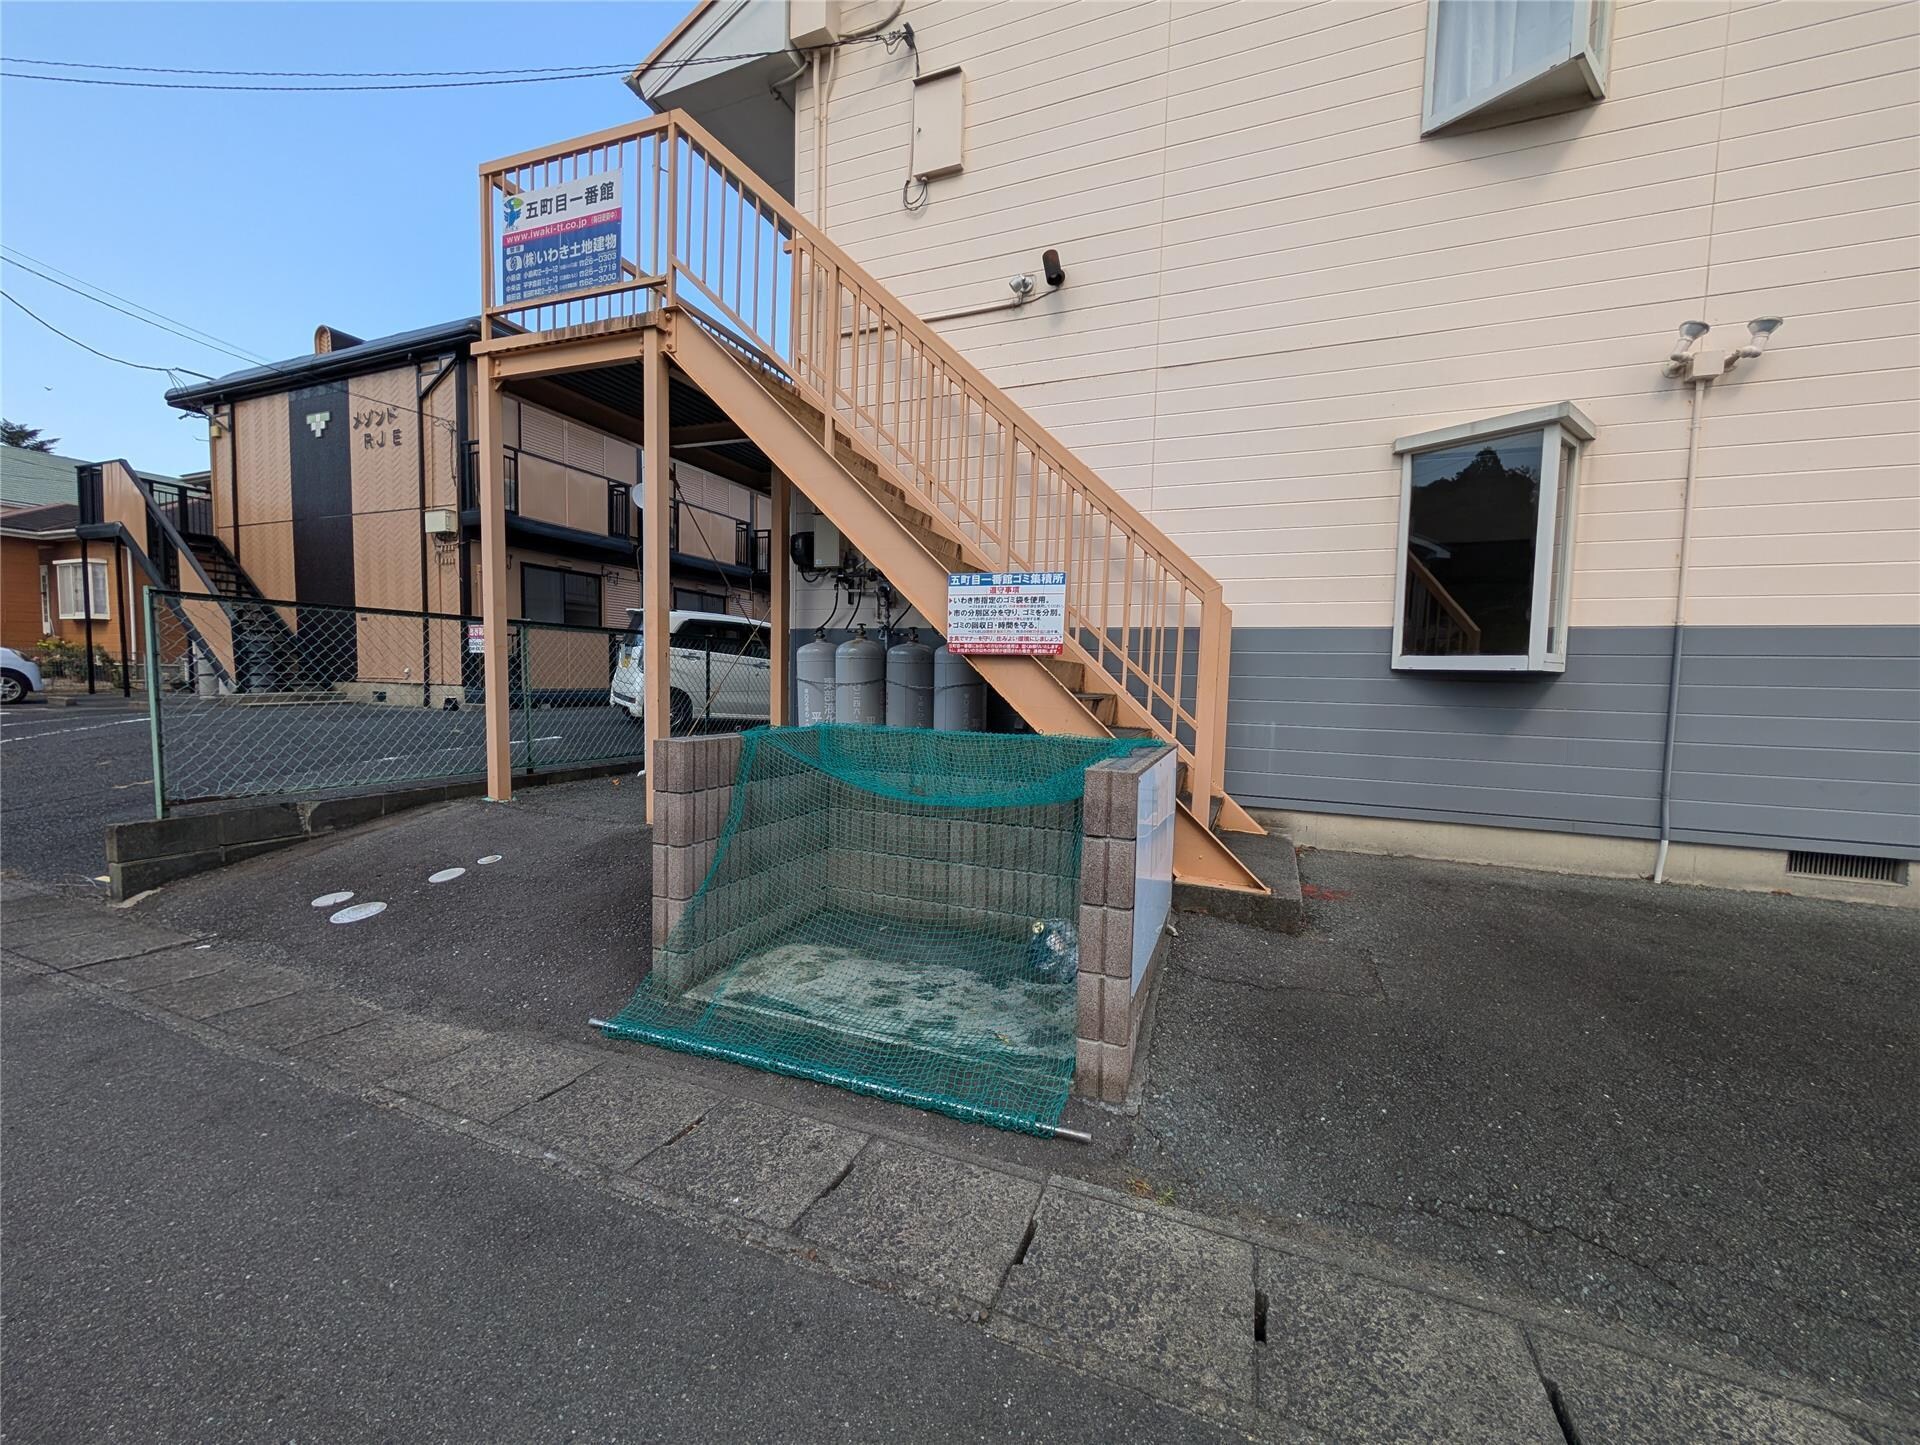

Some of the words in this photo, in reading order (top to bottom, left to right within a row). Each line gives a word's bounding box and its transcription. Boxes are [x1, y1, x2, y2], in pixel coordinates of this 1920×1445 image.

[525, 181, 615, 219] 五町目一番館
[507, 218, 588, 244] www.iwaki-tt.co.jp
[353, 407, 398, 430] メゾンド
[950, 573, 1064, 585] 五町目一番館ゴミ集積所
[953, 596, 1050, 604] いわき市指定のゴミ袋を使用。
[953, 608, 1061, 617] 市の分別区分を守り、ゴミを分別。
[952, 621, 1038, 630] ゴミの回収日・時間を守る。
